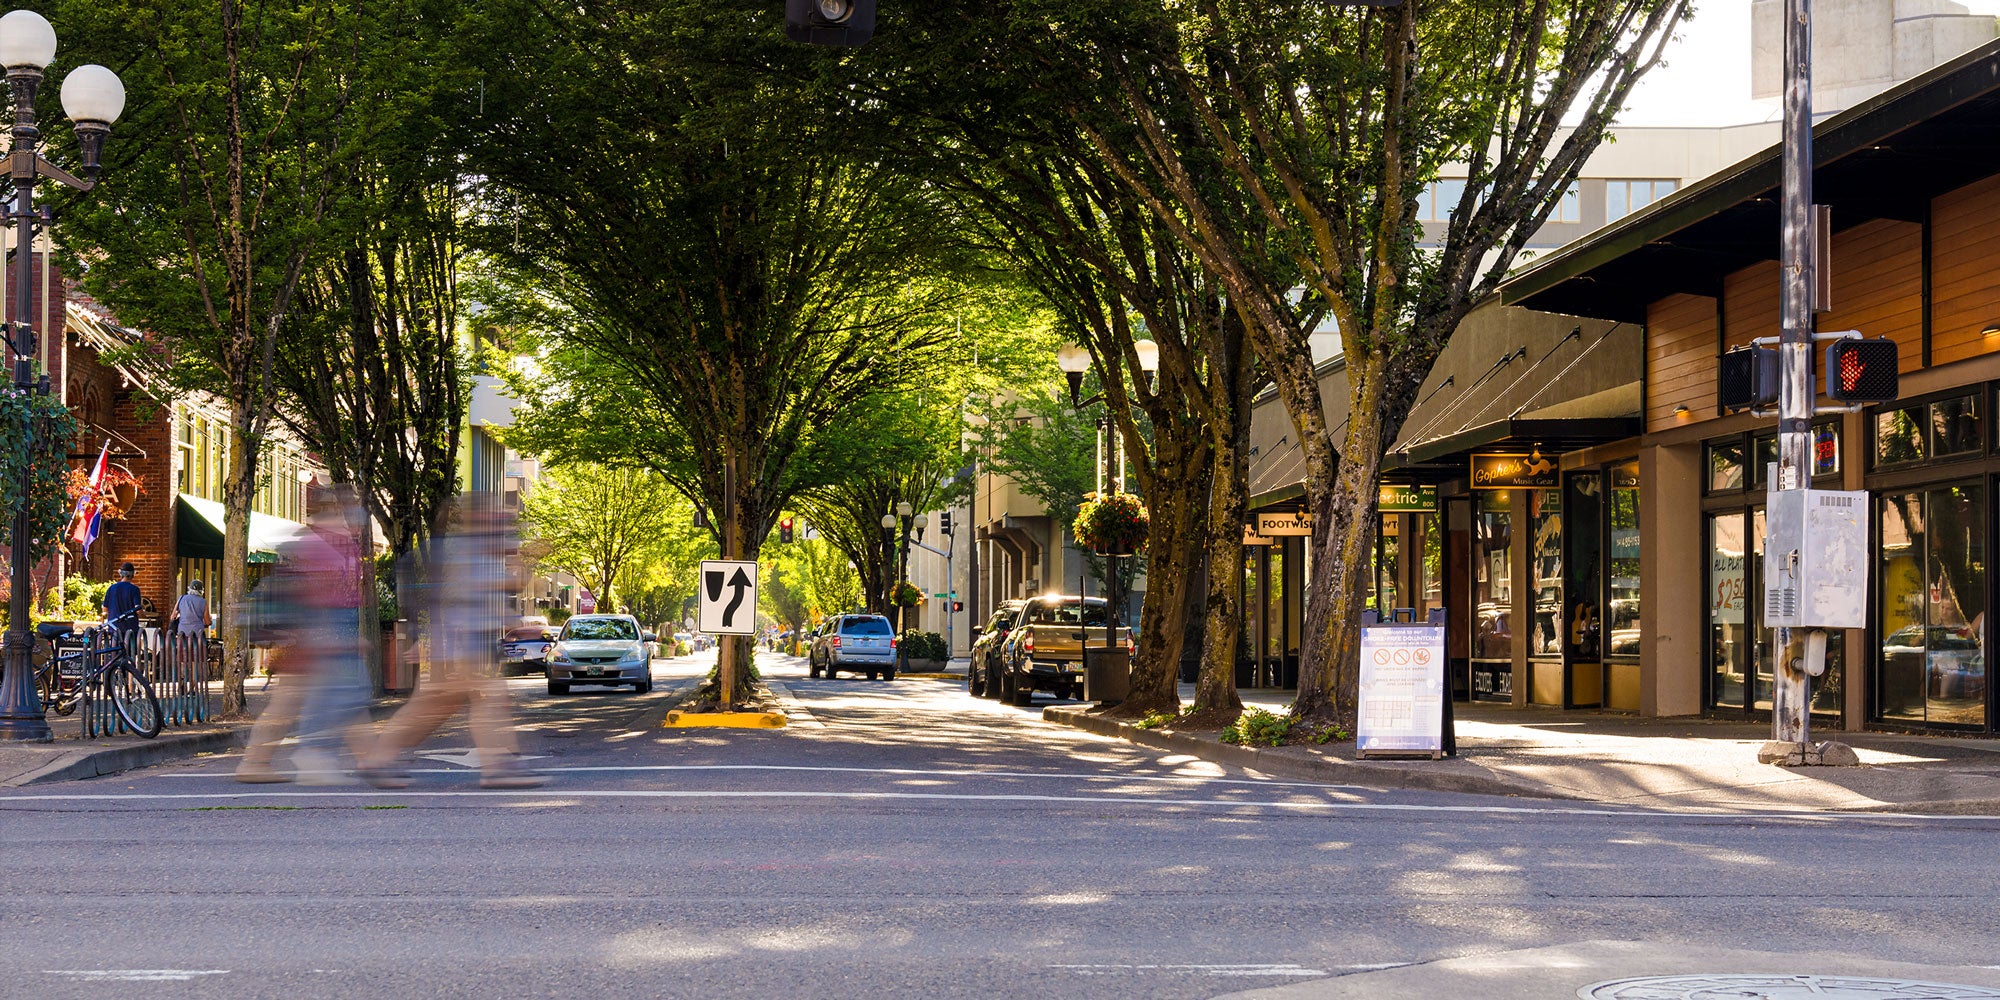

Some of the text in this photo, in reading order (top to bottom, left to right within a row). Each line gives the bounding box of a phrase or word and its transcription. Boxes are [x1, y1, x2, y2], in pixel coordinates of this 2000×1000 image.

[1475, 459, 1522, 483] Gopher's
[1714, 557, 1744, 571] ALL PLAT
